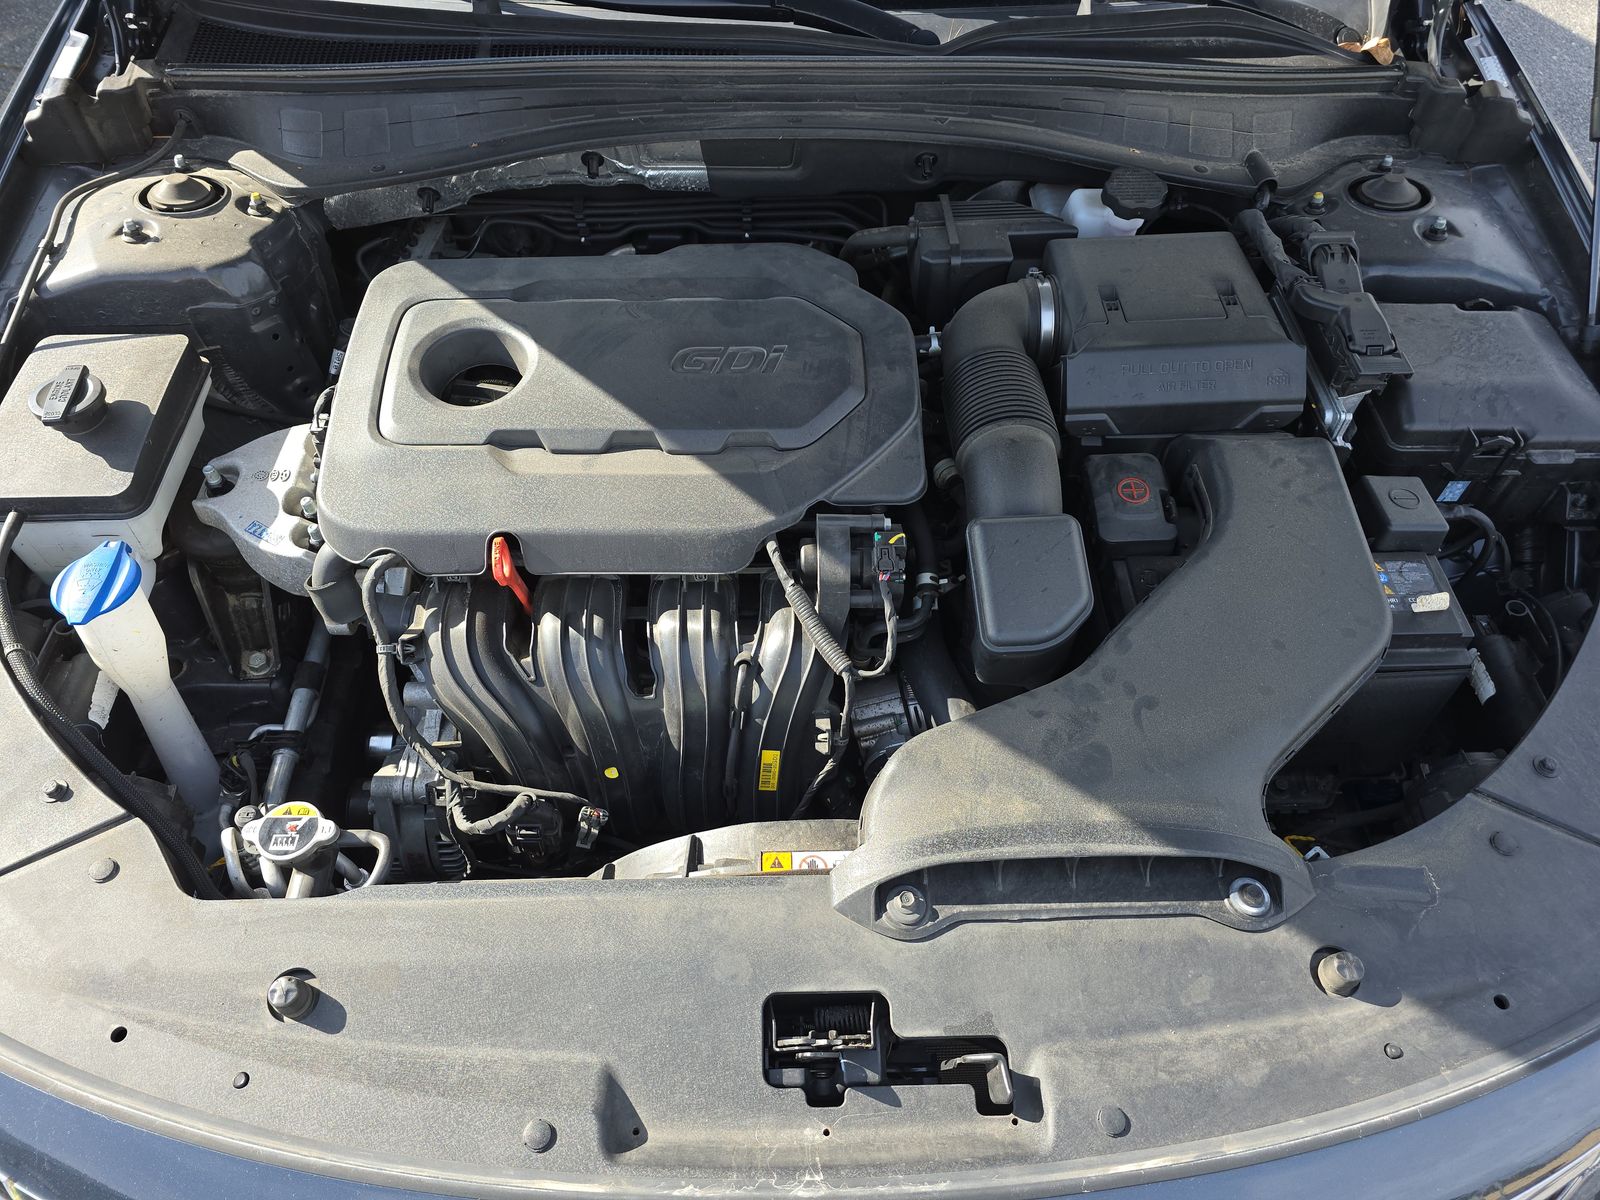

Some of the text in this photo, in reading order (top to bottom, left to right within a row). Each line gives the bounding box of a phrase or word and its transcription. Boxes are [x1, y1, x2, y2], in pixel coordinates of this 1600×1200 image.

[670, 345, 788, 376] GDi
[1120, 359, 1254, 376] PULL OUT TO OPEN
[49, 381, 64, 401] ENGINE
[57, 379, 75, 402] COOLANT
[1155, 380, 1217, 392] AIR FILTER
